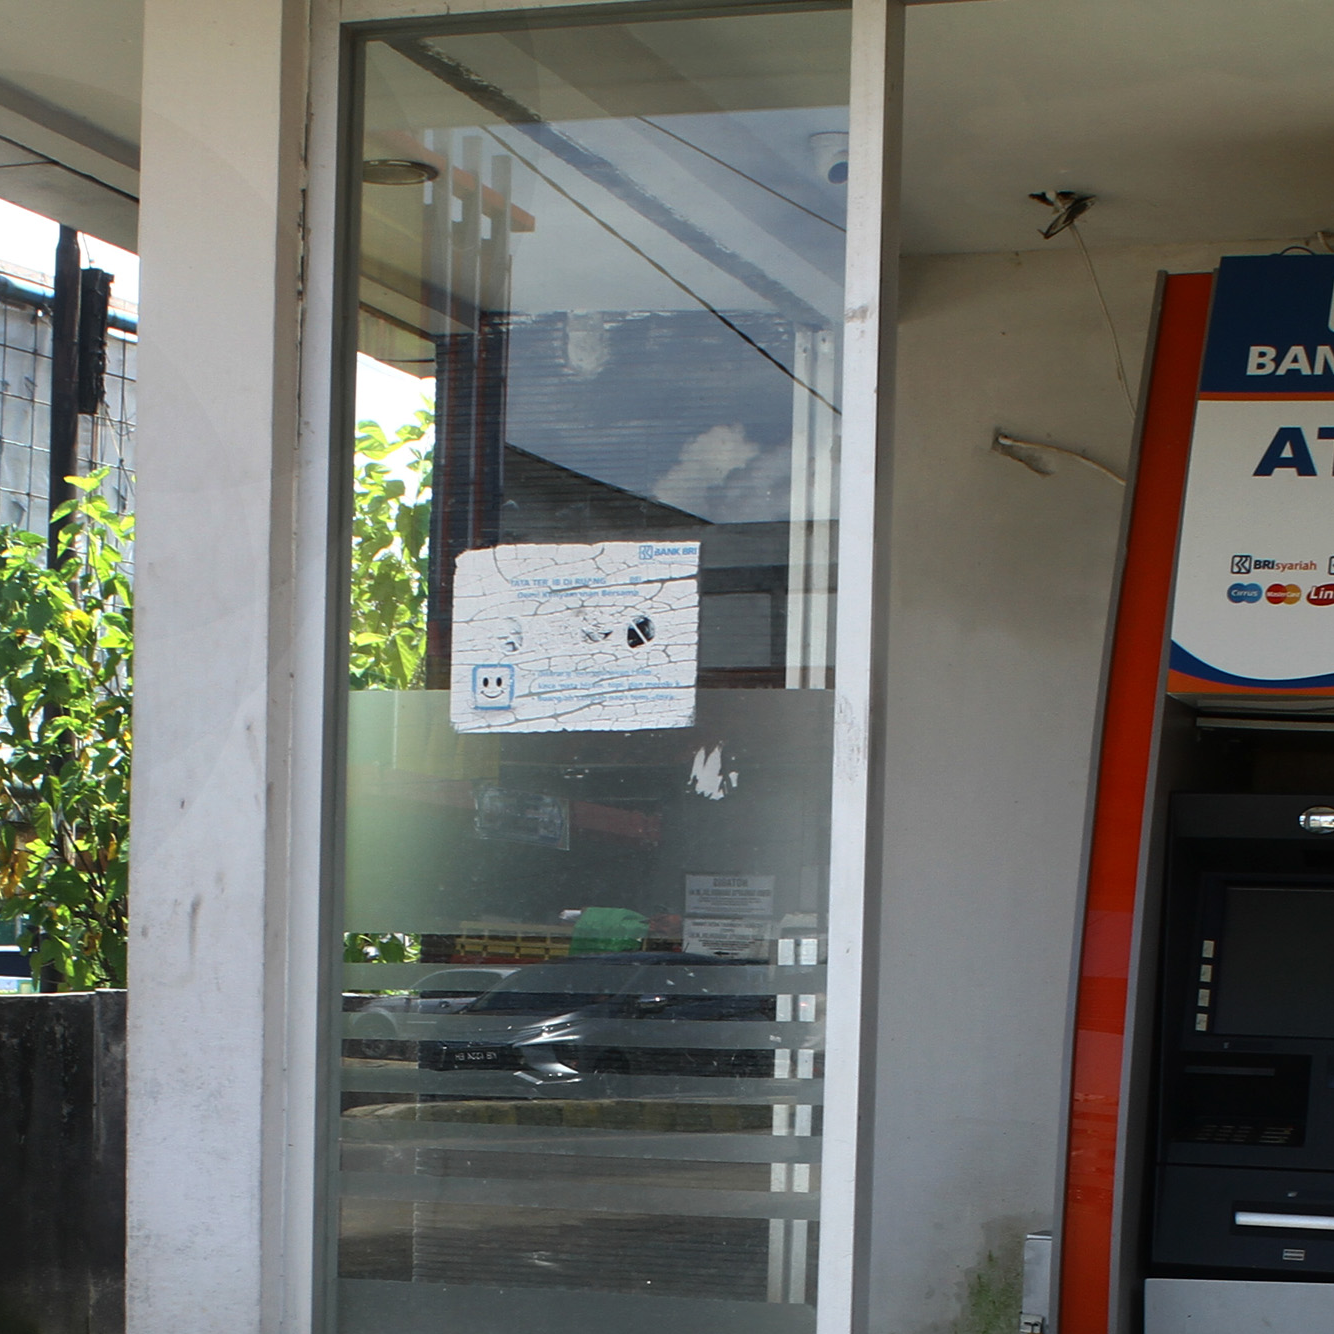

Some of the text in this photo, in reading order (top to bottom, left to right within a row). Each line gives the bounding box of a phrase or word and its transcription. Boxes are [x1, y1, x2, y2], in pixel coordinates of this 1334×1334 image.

[653, 547, 698, 556] BANK BRI
[1253, 559, 1317, 572] BRIsyariah
[1231, 588, 1259, 597] Cirrus
